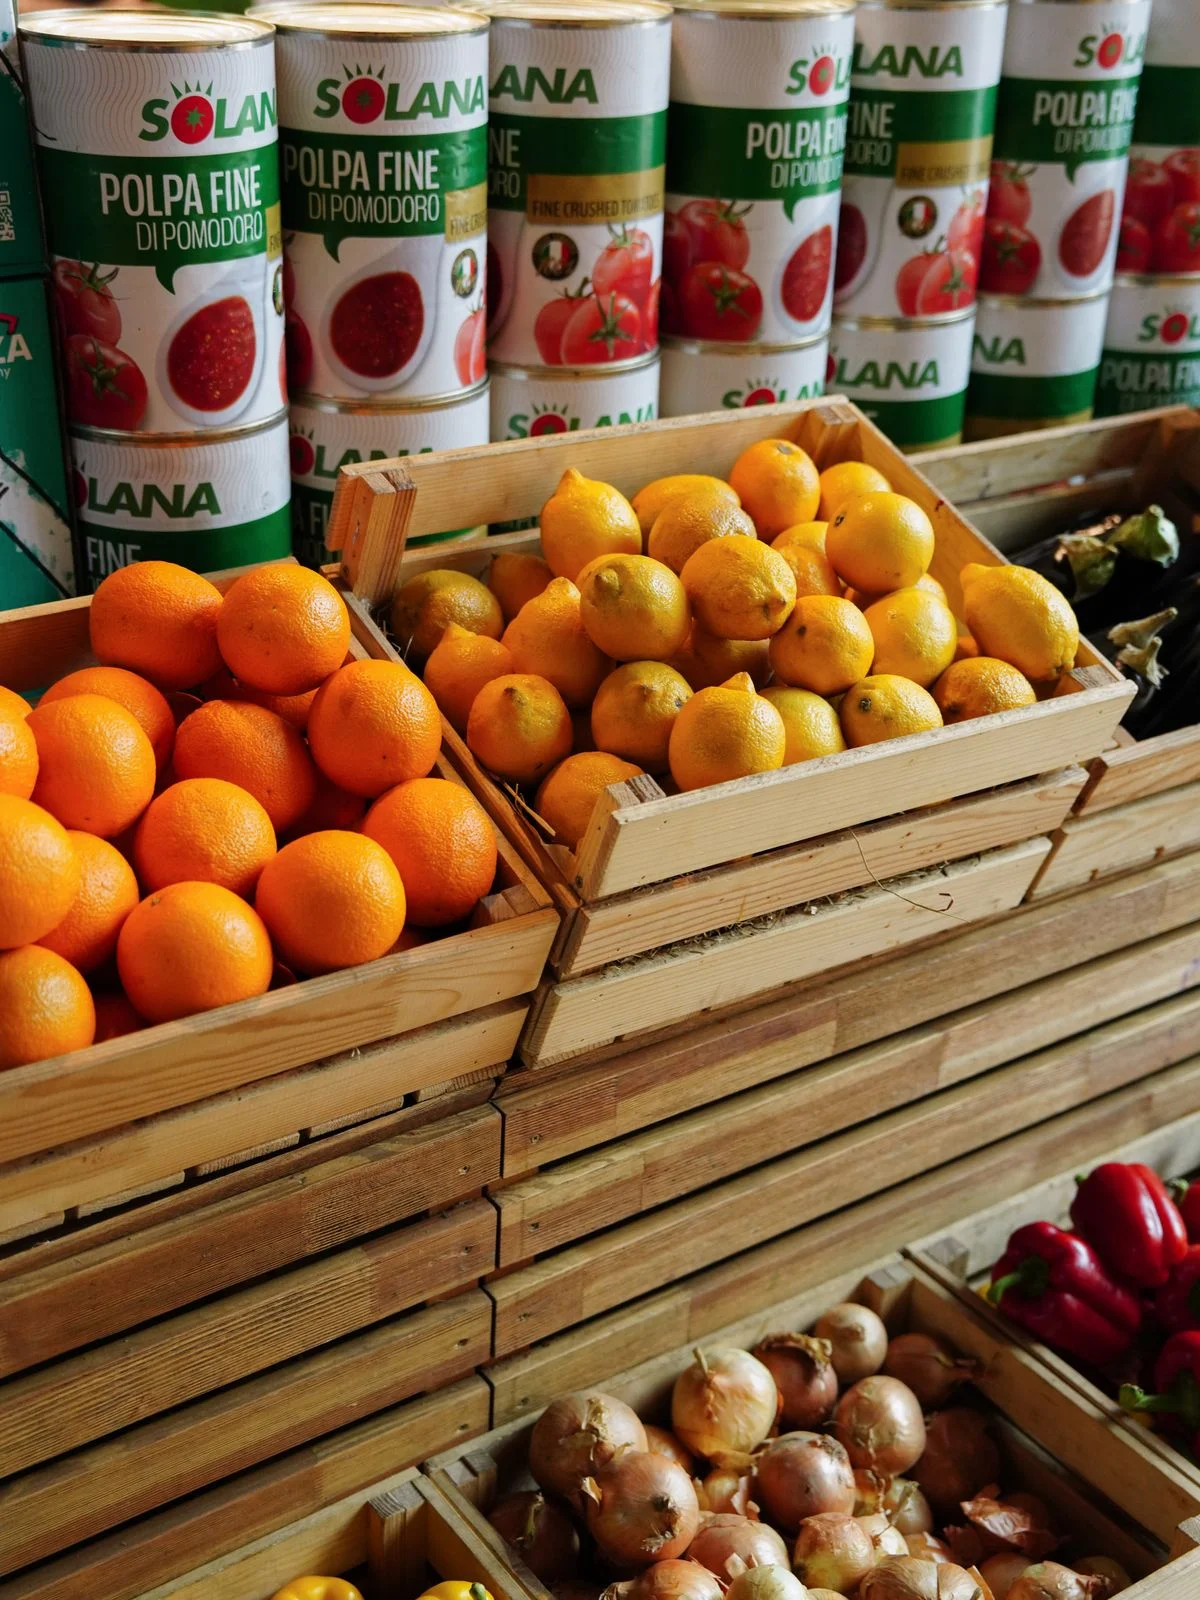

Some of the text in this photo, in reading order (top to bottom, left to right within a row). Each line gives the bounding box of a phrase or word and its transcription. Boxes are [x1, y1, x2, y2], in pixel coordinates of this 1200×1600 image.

[313, 75, 485, 124] SOLANA
[490, 64, 599, 104] ANA
[1033, 90, 1107, 127] POLPA
[746, 120, 821, 160] POLPA
[284, 144, 440, 192] POLPA FINE
[101, 164, 262, 217] POLPA FINE
[308, 191, 440, 224] DI POMODORO
[532, 200, 561, 218] FINE
[563, 199, 619, 218] CRUSHED
[136, 221, 158, 251] DI
[163, 210, 263, 250] POMODORO
